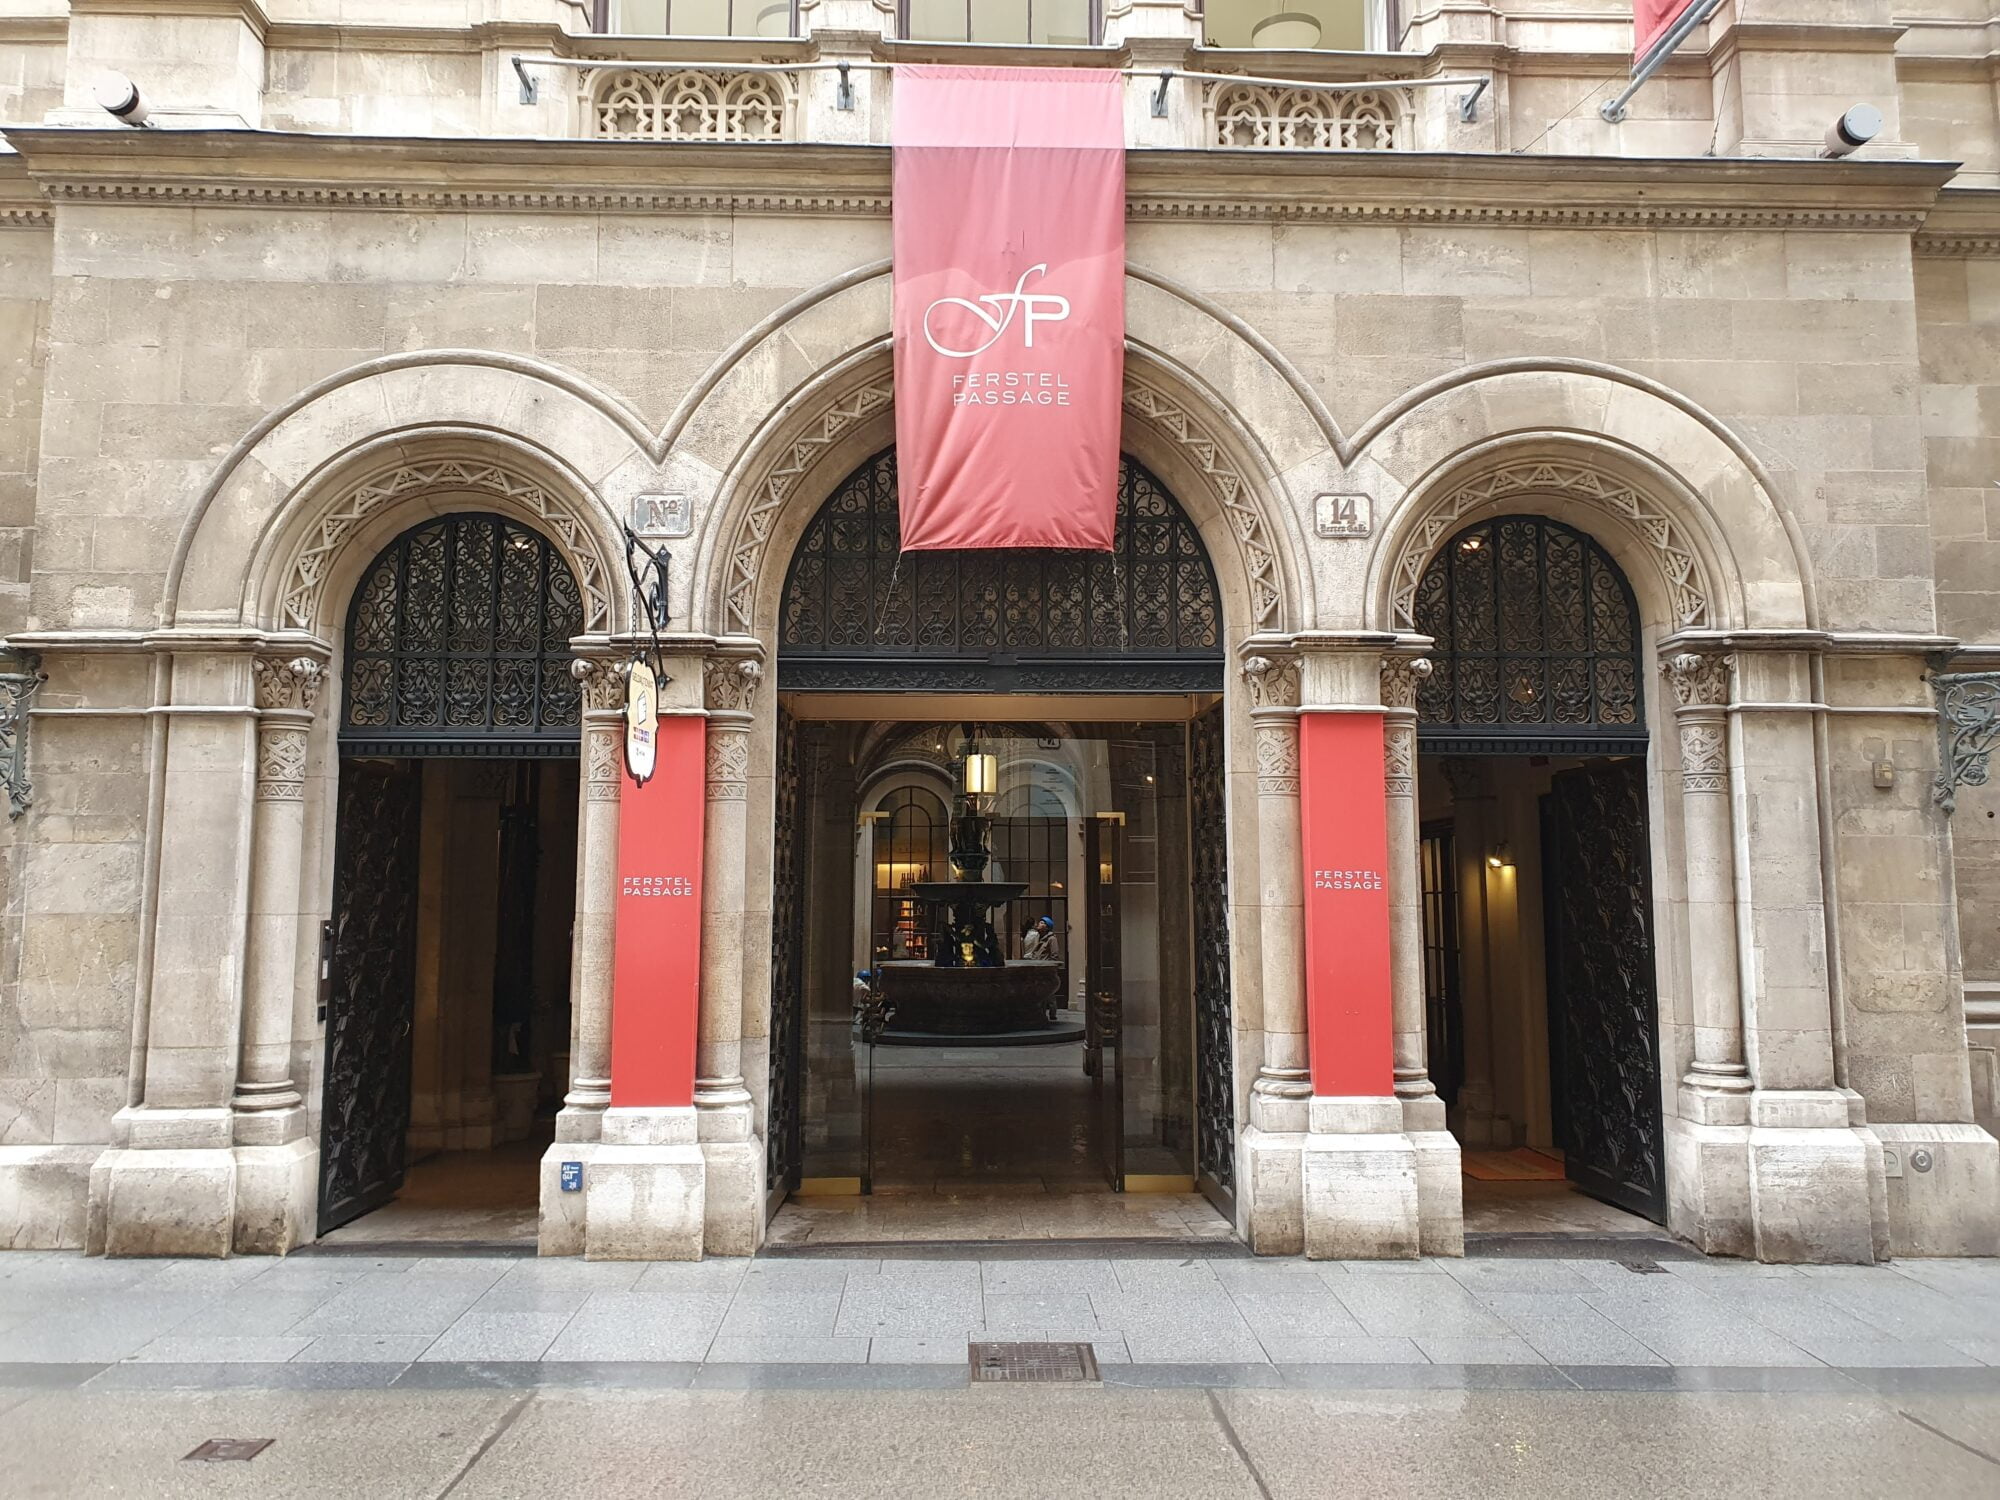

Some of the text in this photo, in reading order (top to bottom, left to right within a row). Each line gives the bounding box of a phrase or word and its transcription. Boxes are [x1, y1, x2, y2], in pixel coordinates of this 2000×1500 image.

[953, 372, 1069, 388] FERSTEL
[953, 391, 1070, 407] PASSAGE
[1330, 498, 1357, 524] 14
[1315, 870, 1382, 880] FERSTEL
[623, 877, 692, 886] FERSTEL
[1315, 880, 1382, 890] PASSAGE
[623, 887, 692, 896] PASSAGE
